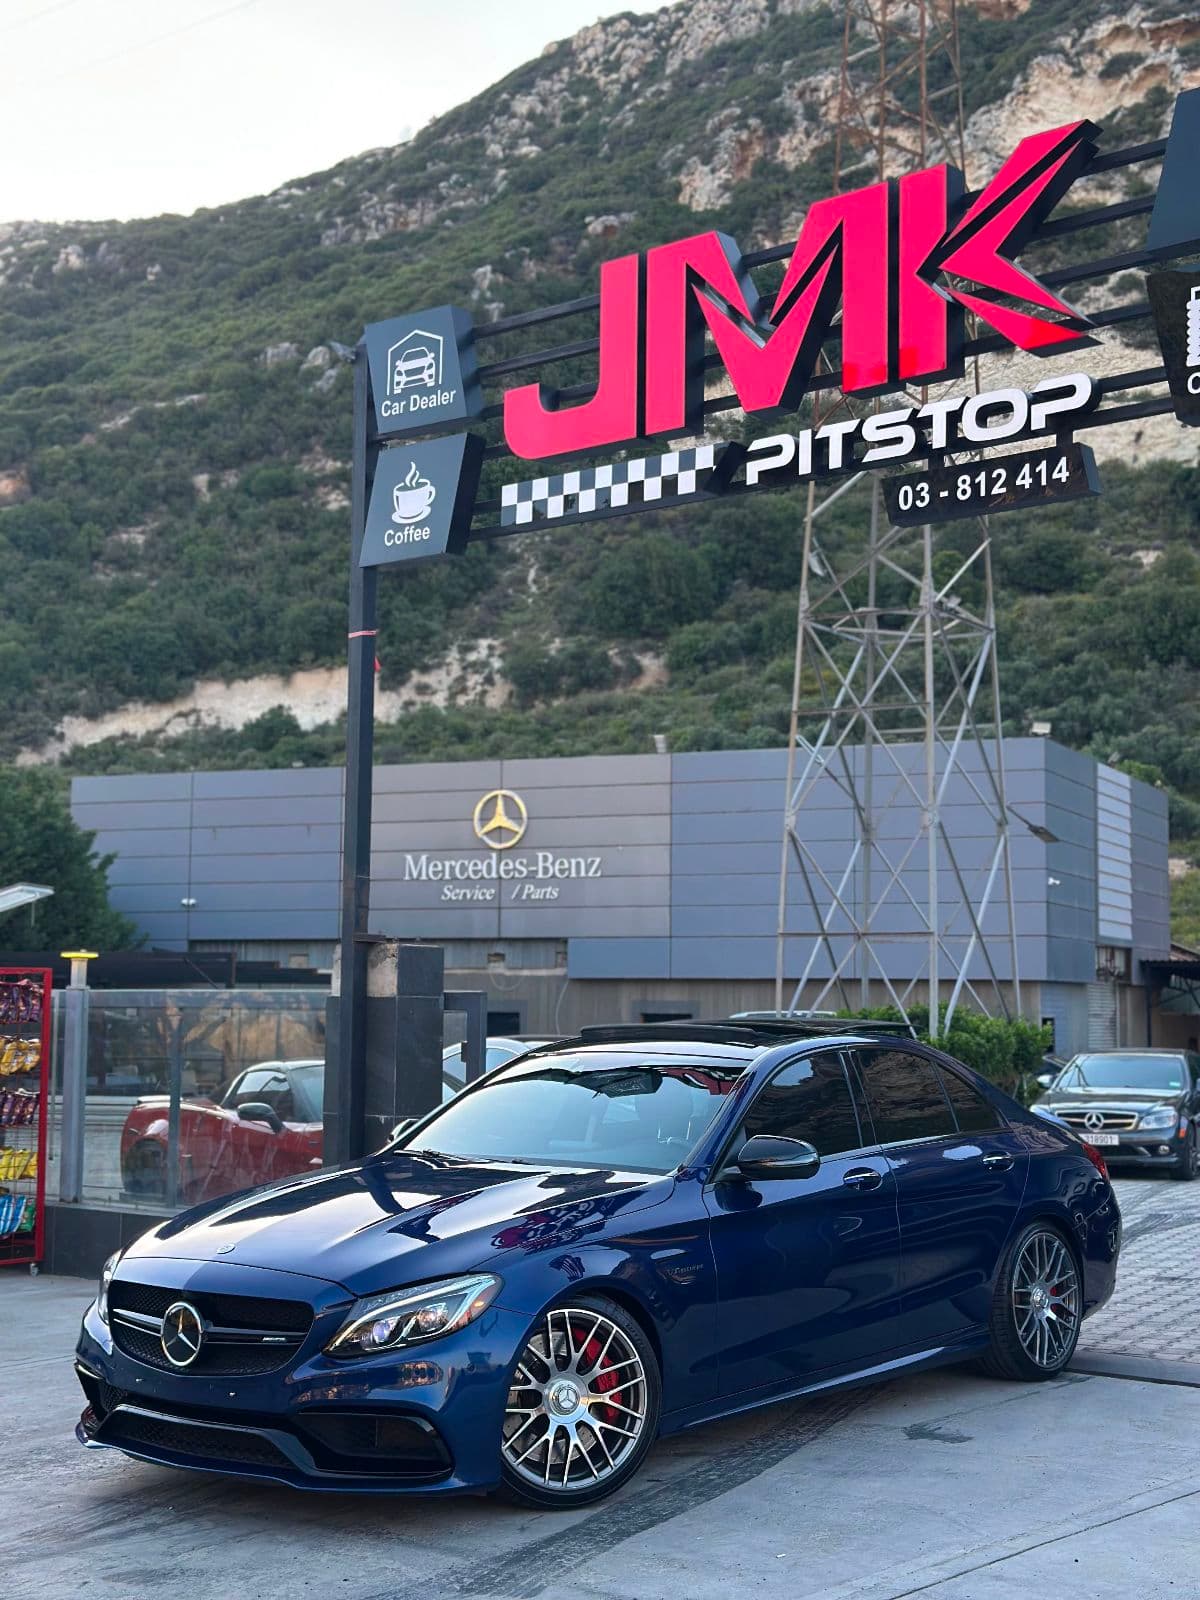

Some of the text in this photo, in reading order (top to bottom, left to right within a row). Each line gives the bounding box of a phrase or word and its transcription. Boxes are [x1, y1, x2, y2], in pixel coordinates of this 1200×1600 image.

[503, 118, 1093, 460] JMK
[381, 388, 457, 417] Car Dealer
[745, 372, 1093, 486] PITSTOP
[898, 481, 930, 511] 03
[956, 467, 1007, 500] 812
[1015, 455, 1071, 489] 414
[384, 525, 431, 547] Coffee
[403, 851, 602, 881] Mercedes-Benz
[441, 884, 496, 901] Service
[521, 884, 560, 900] Parts
